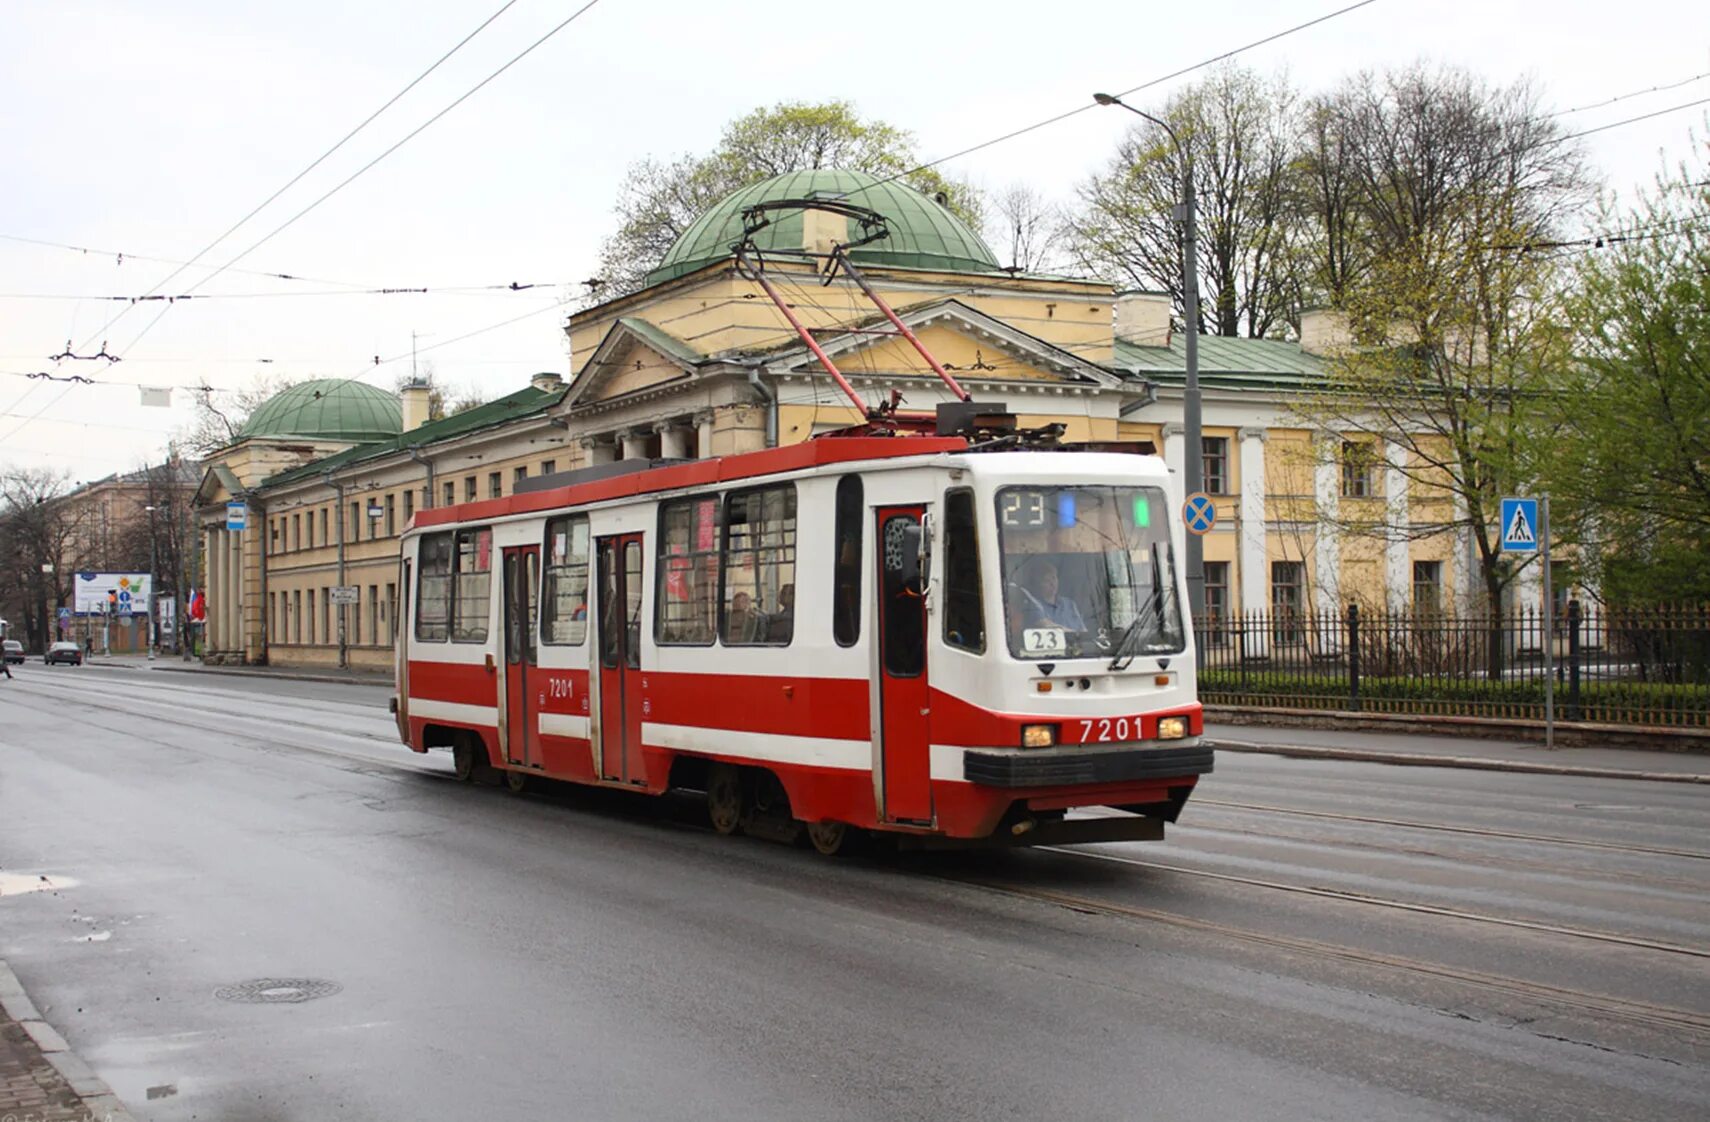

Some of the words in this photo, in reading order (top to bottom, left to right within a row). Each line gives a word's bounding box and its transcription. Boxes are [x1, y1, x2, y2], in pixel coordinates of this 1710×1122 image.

[1003, 493, 1043, 525] 23
[1031, 631, 1058, 650] 23
[549, 678, 573, 698] 7201
[1080, 717, 1143, 743] 7201
